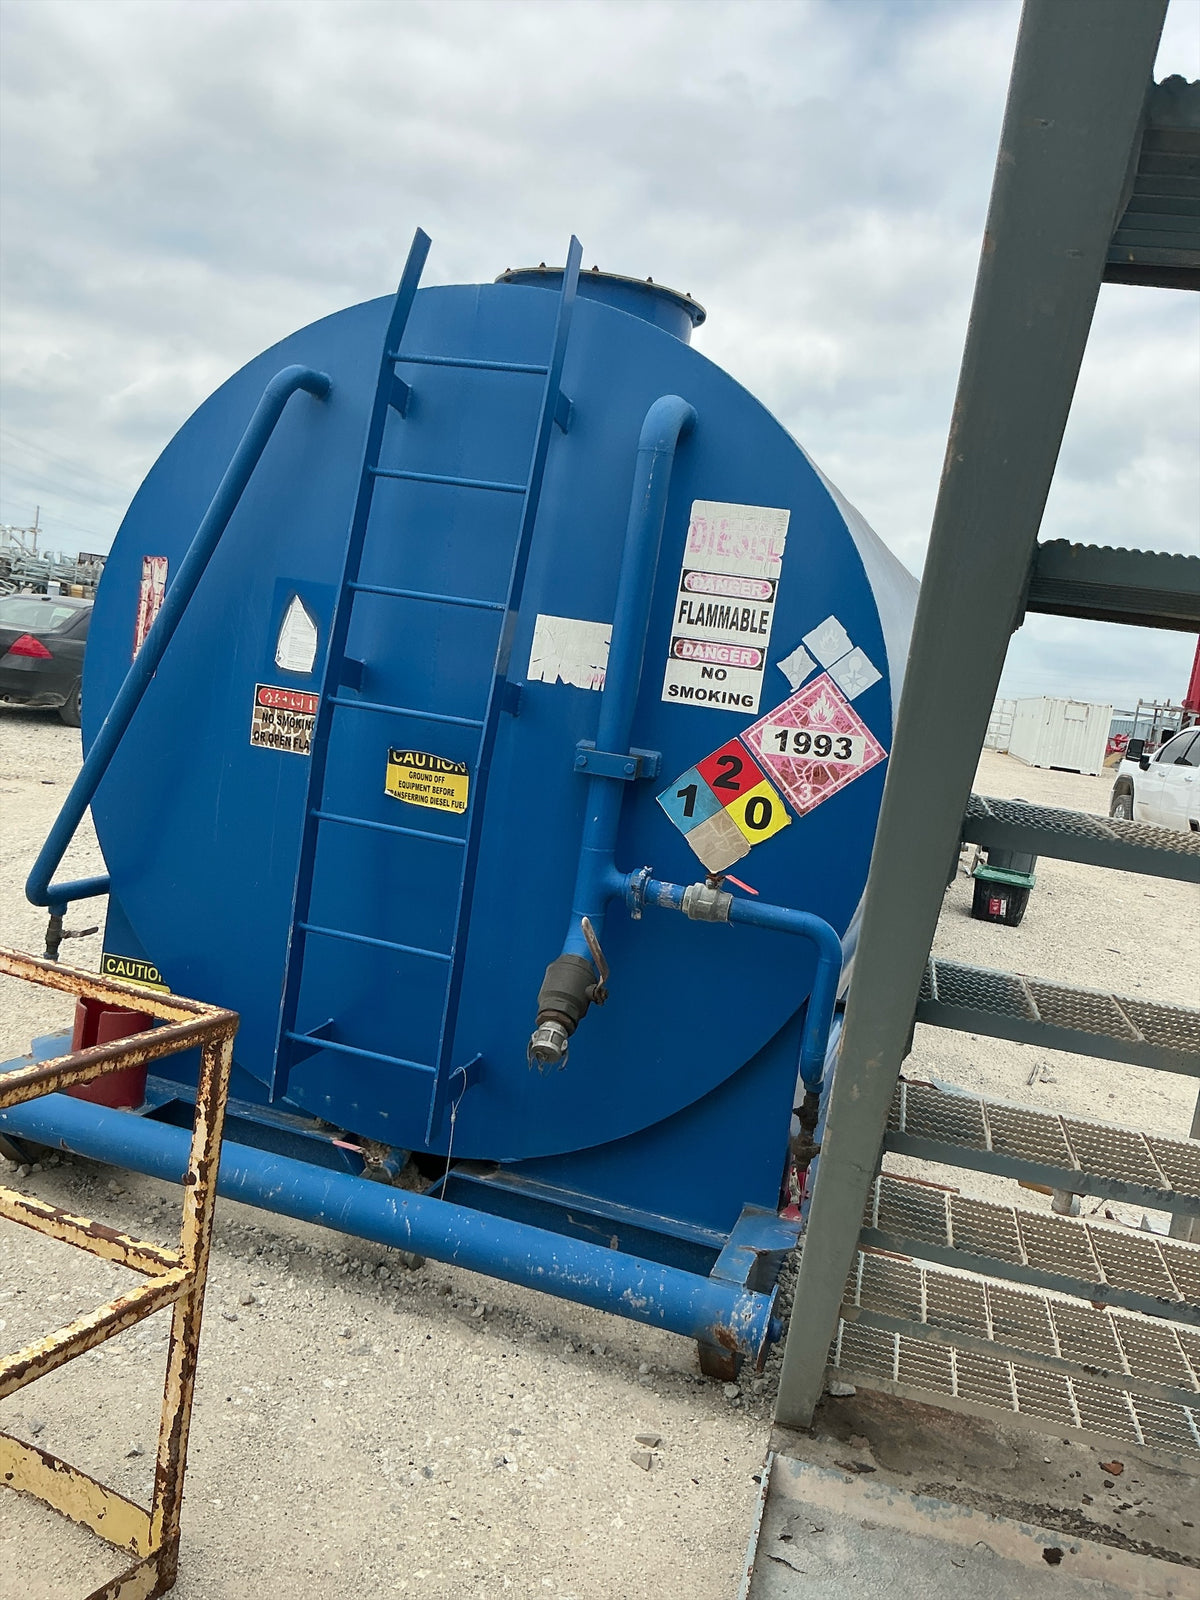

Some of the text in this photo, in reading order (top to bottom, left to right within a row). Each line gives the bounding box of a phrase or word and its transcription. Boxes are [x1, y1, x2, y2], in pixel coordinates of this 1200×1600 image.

[692, 577, 764, 598] DANGER
[678, 600, 769, 634] FLAMMABLE
[682, 643, 752, 665] DANGER
[701, 667, 727, 681] NO
[668, 684, 754, 707] SMOKING
[262, 712, 274, 724] NO
[253, 730, 310, 750] OR OPEN FLA
[775, 729, 853, 760] 1993
[408, 771, 445, 784] GROUND OFF
[713, 755, 743, 790] 2
[387, 788, 465, 810] RANSFERRING DIESEL FUEL
[398, 780, 455, 797] EQUIPMENT BEFORE
[800, 783, 812, 800] 3
[677, 784, 698, 817] 1
[744, 796, 773, 830] 0
[106, 958, 162, 982] CAUTIO
